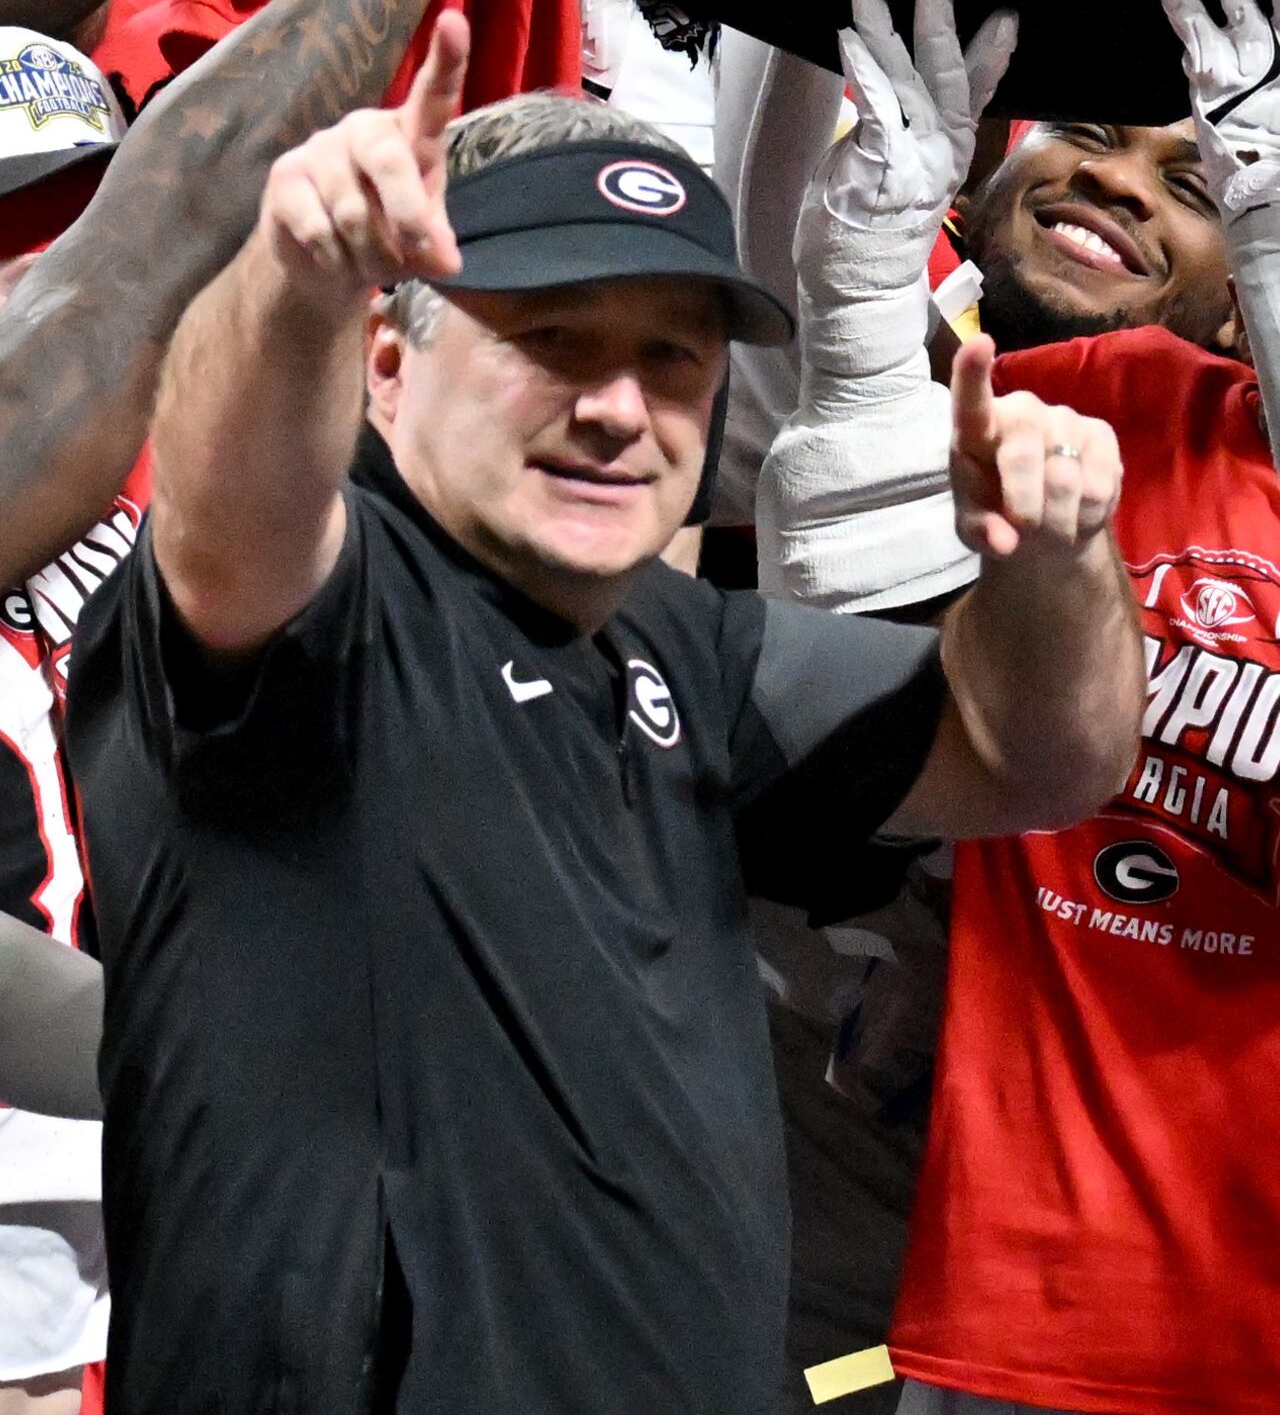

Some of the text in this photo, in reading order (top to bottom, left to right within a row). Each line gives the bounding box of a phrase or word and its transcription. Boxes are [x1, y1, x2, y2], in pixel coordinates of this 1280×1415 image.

[608, 166, 683, 208] G
[1197, 587, 1236, 625] SEC
[632, 667, 675, 739] G
[1106, 848, 1180, 897] G
[1088, 908, 1174, 946] MEANS
[1180, 928, 1256, 956] MORE
